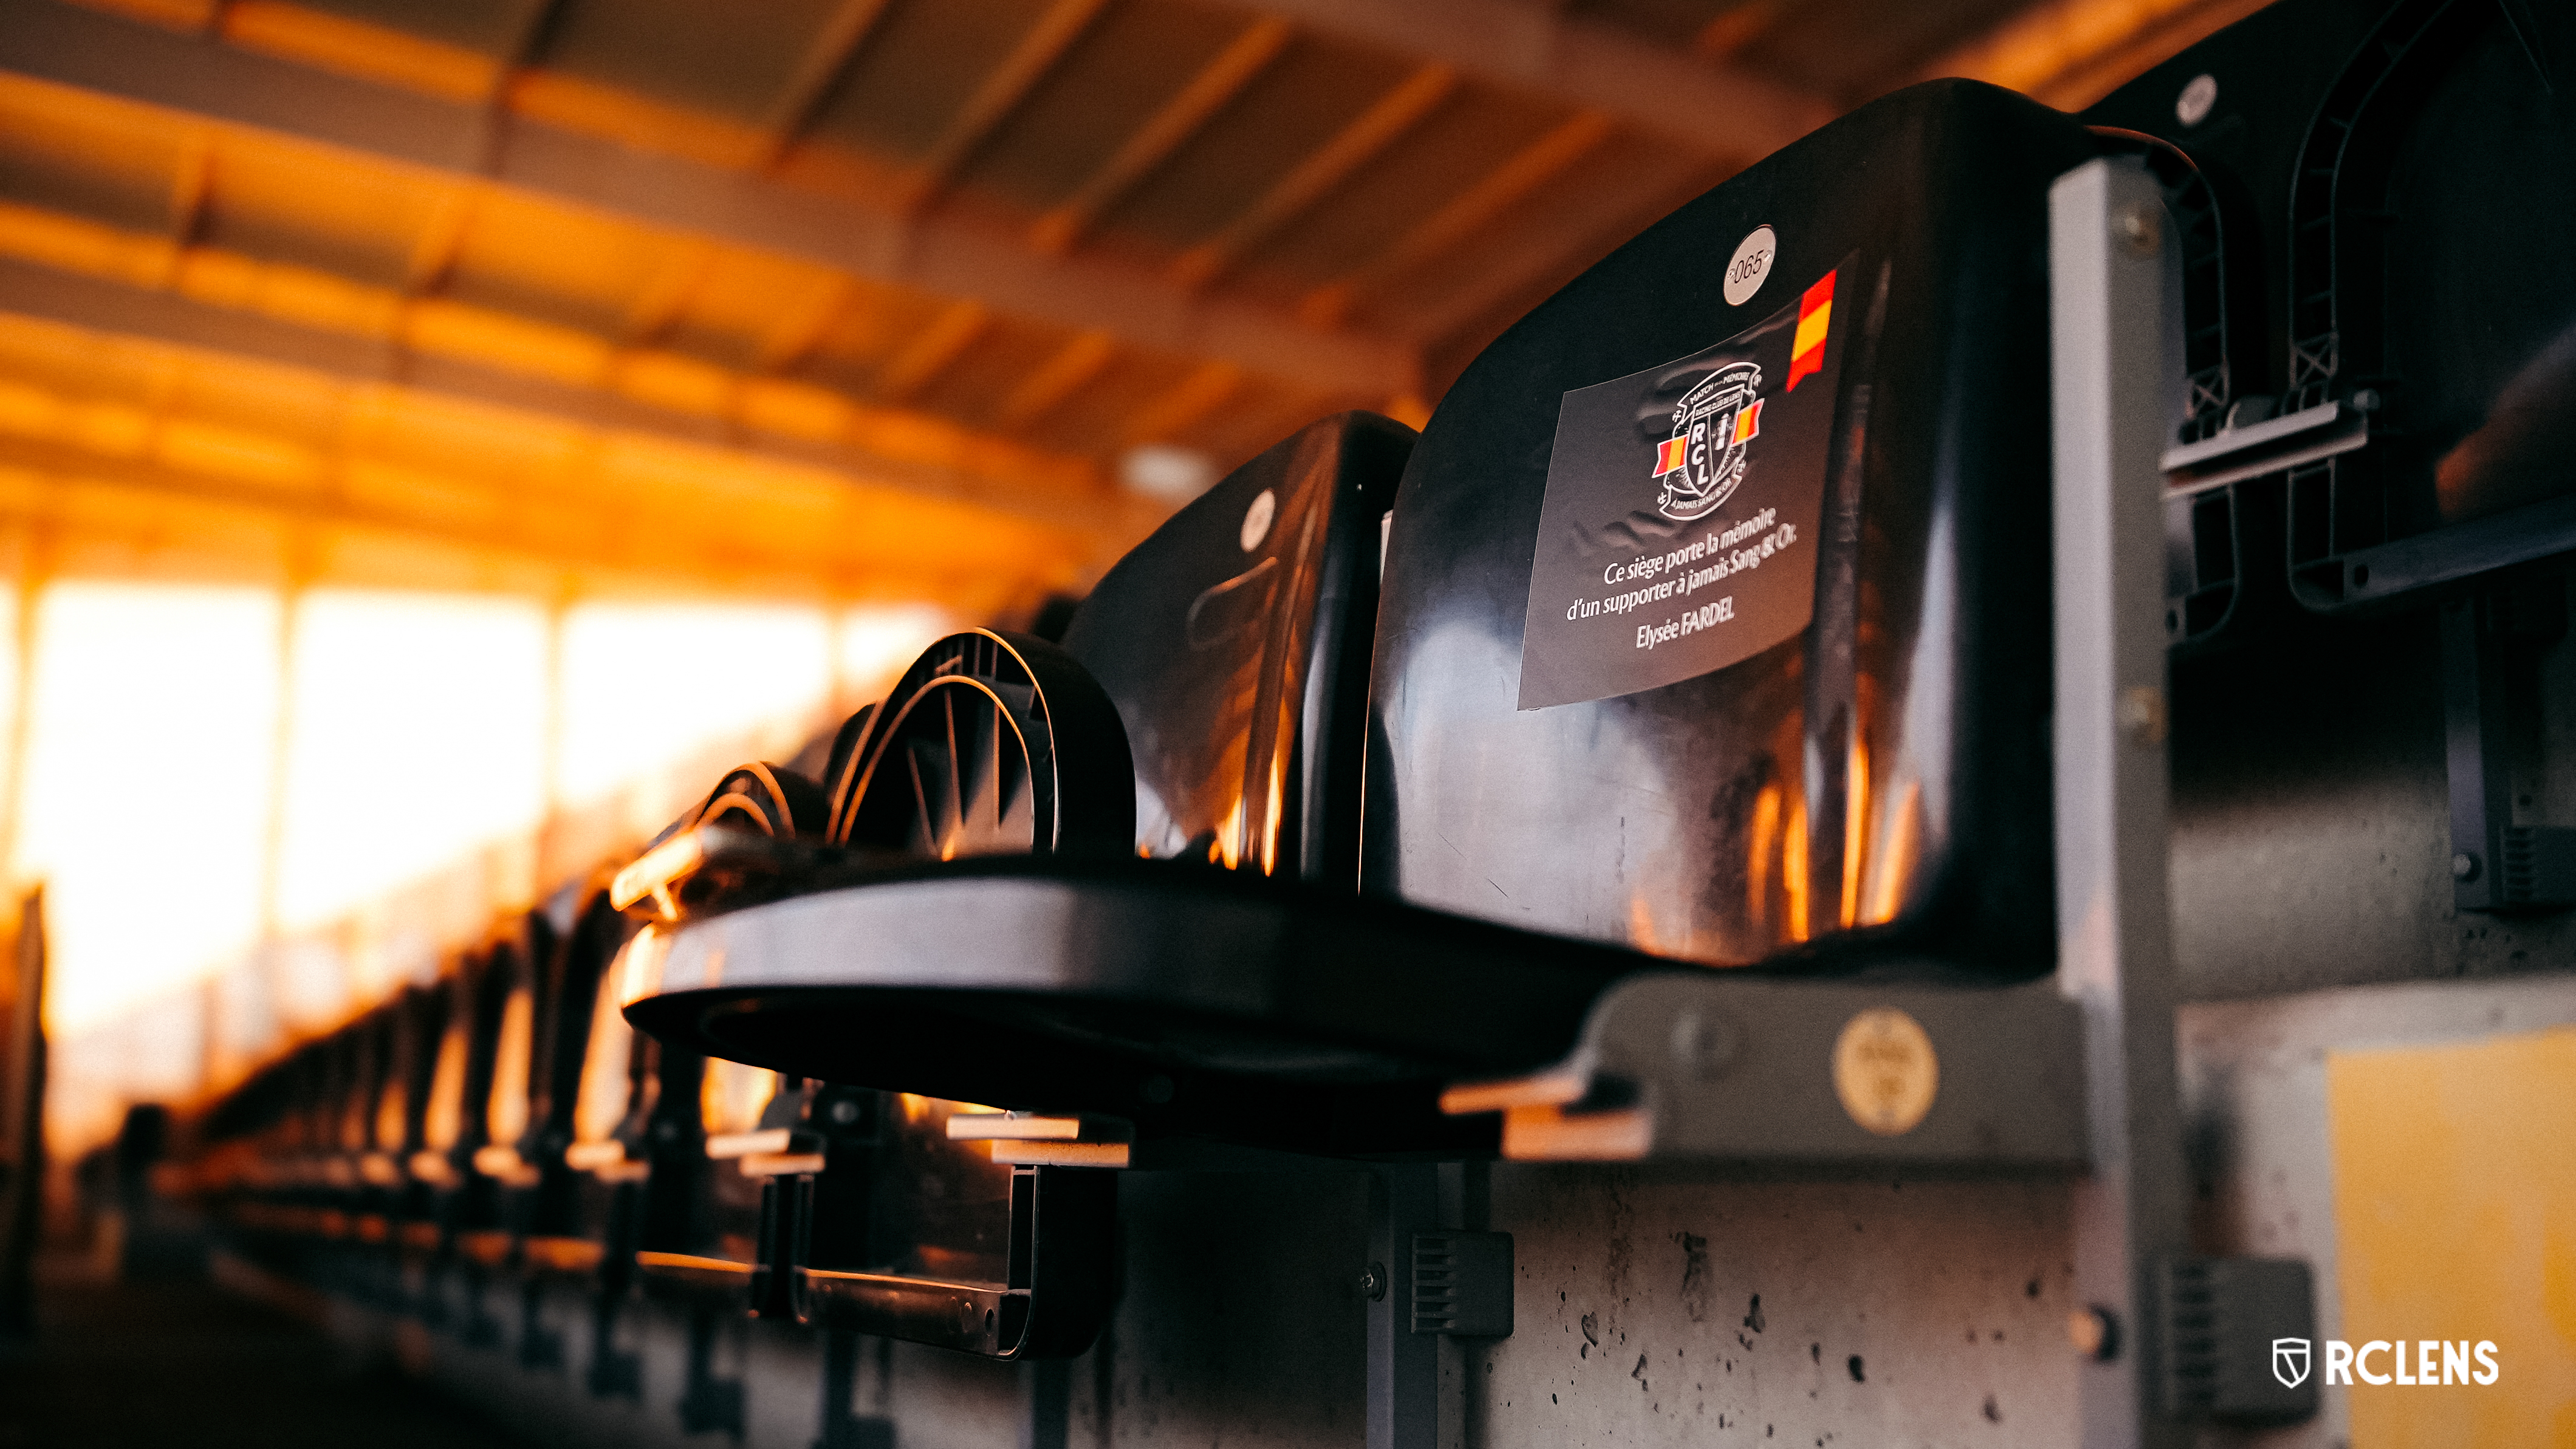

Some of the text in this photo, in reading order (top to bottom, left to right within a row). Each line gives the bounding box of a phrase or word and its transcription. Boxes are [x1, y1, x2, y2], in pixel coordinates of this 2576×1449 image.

[1735, 248, 1764, 284] 065
[1690, 382, 1714, 405] MATCH
[1604, 507, 1776, 584] Ce siège porte la mémoire
[1566, 598, 1601, 621] d'un
[1603, 580, 1676, 615] supporter
[1676, 572, 1686, 595] à
[1685, 569, 1730, 597] jamais
[1729, 549, 1761, 574] Sang
[1760, 533, 1776, 559] &
[1636, 595, 1735, 649] Elysée FARDEL
